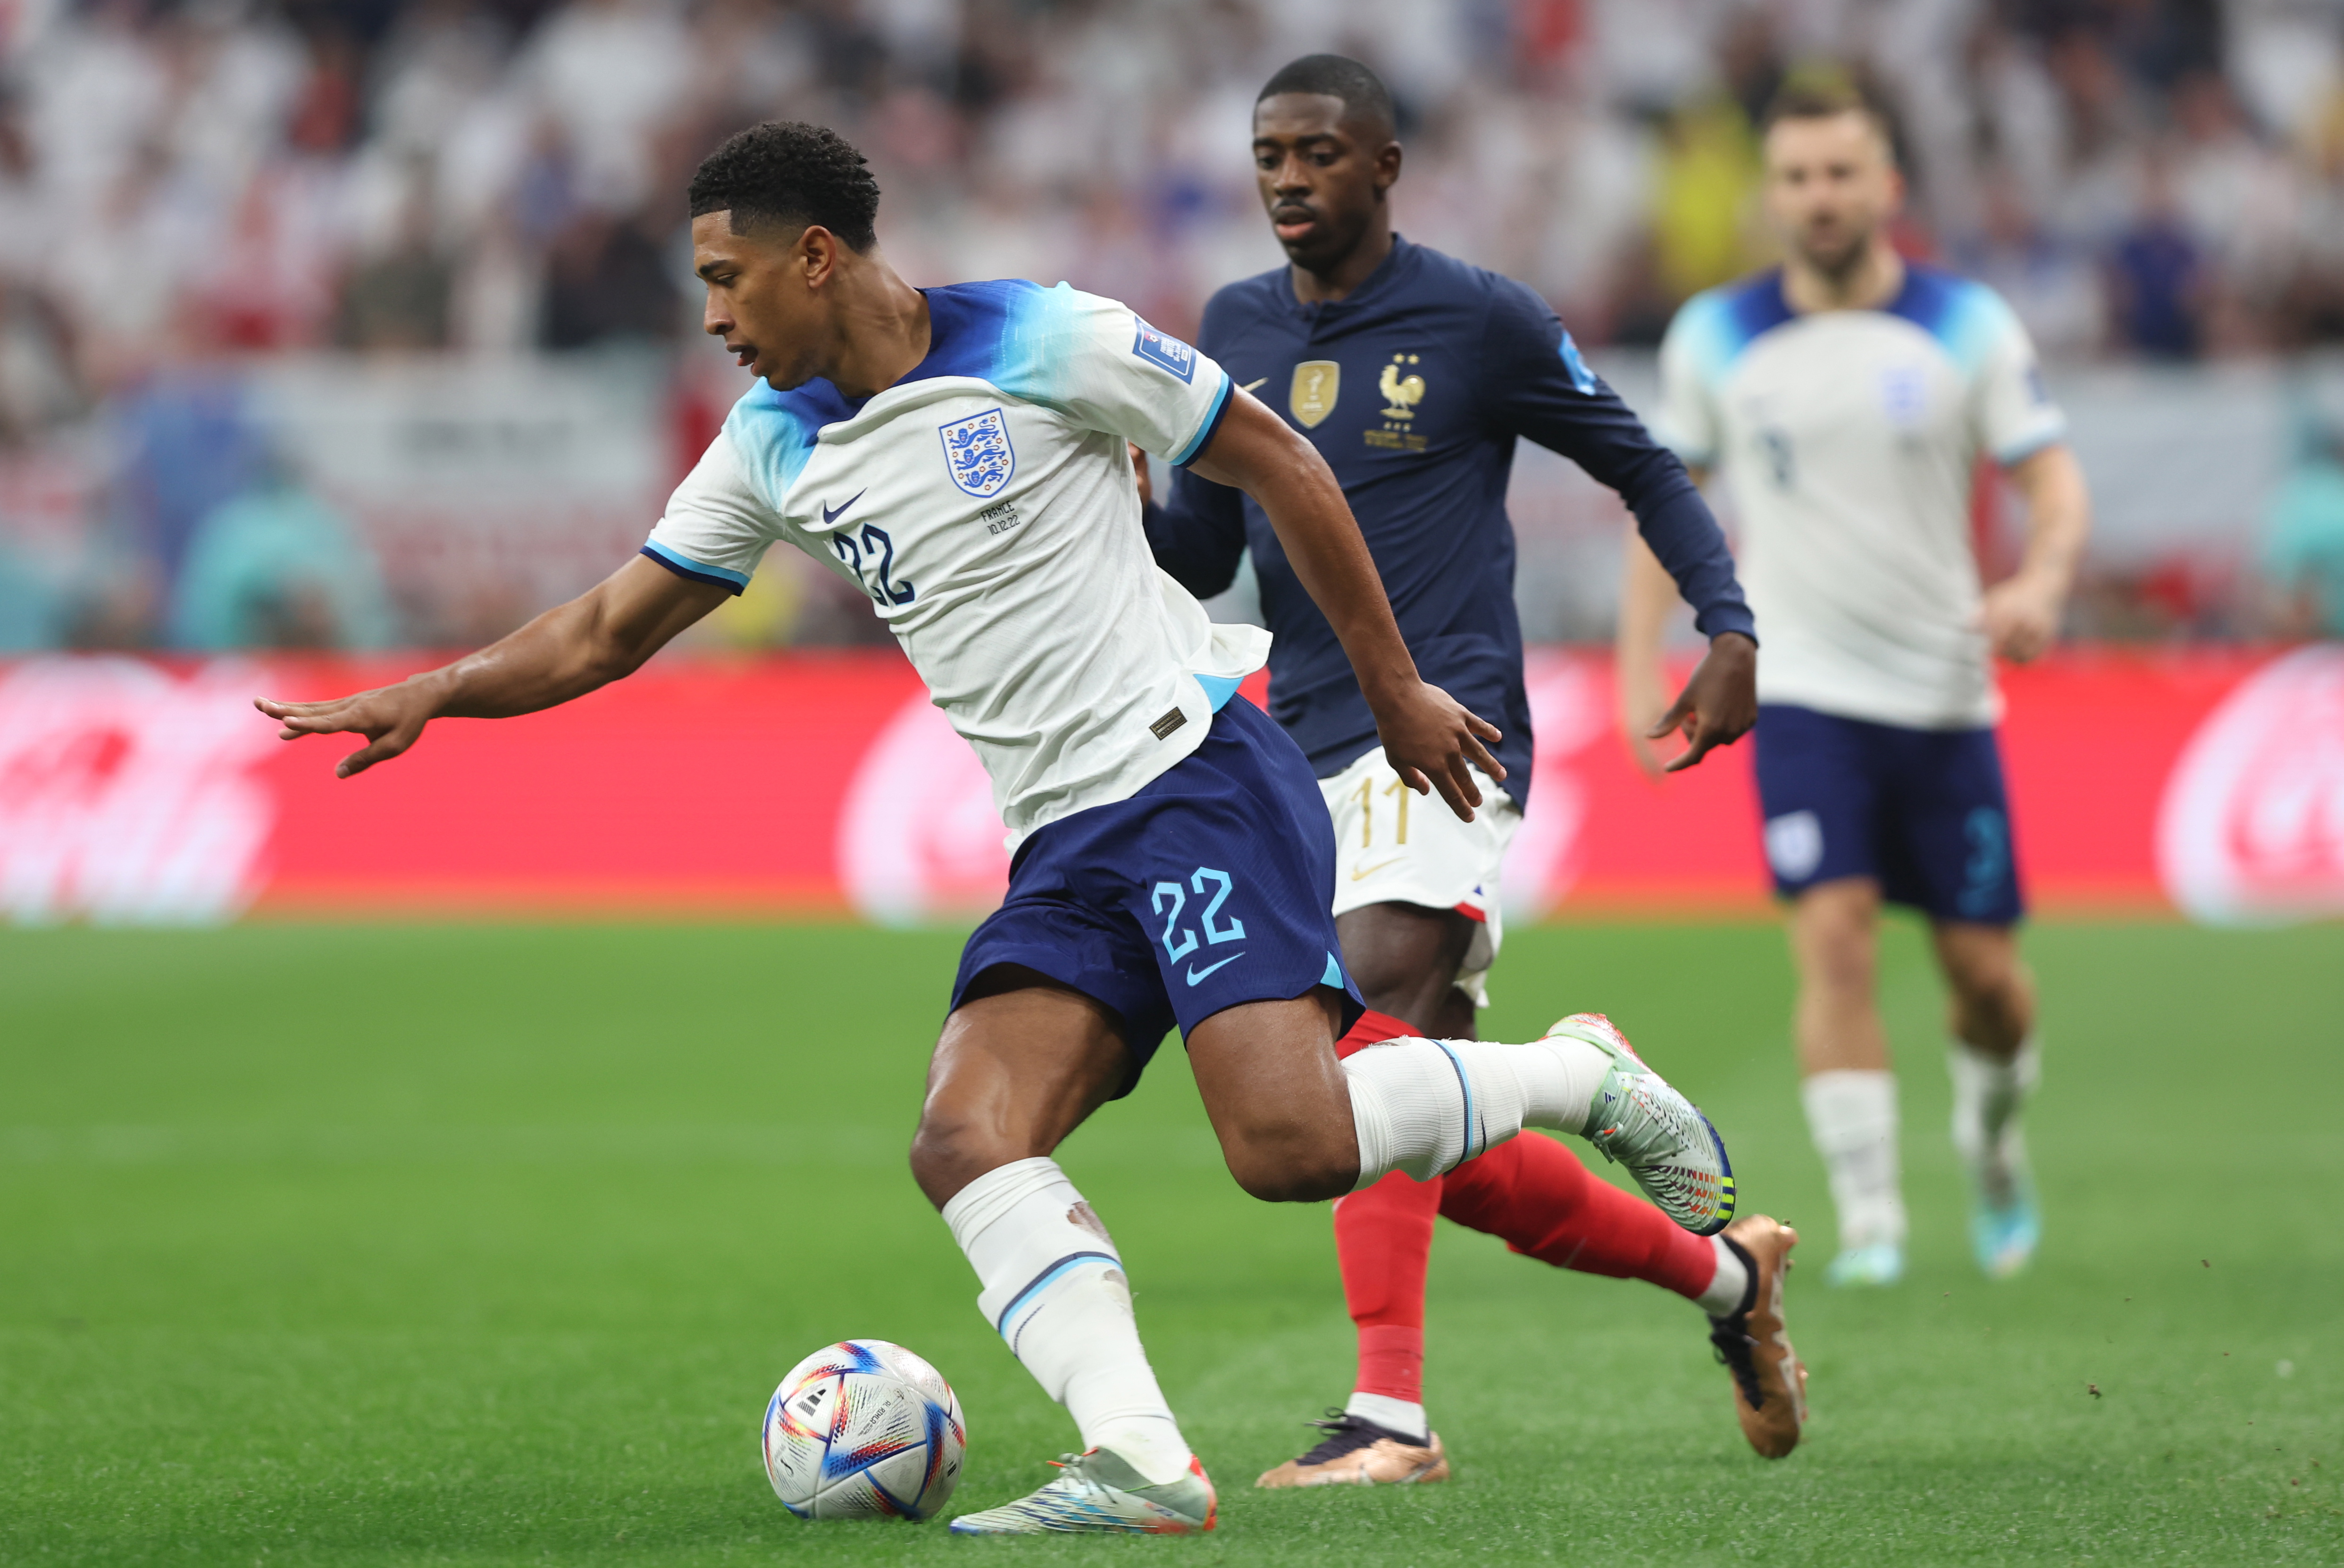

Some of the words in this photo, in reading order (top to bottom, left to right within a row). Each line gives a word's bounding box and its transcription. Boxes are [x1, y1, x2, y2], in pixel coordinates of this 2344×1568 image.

[980, 500, 1014, 522] FRANCE
[987, 515, 1021, 535] 10.12.22
[833, 522, 915, 607] 22
[1350, 776, 1409, 848] 11
[1151, 866, 1247, 967] 22
[870, 1407, 885, 1424] RIHLA
